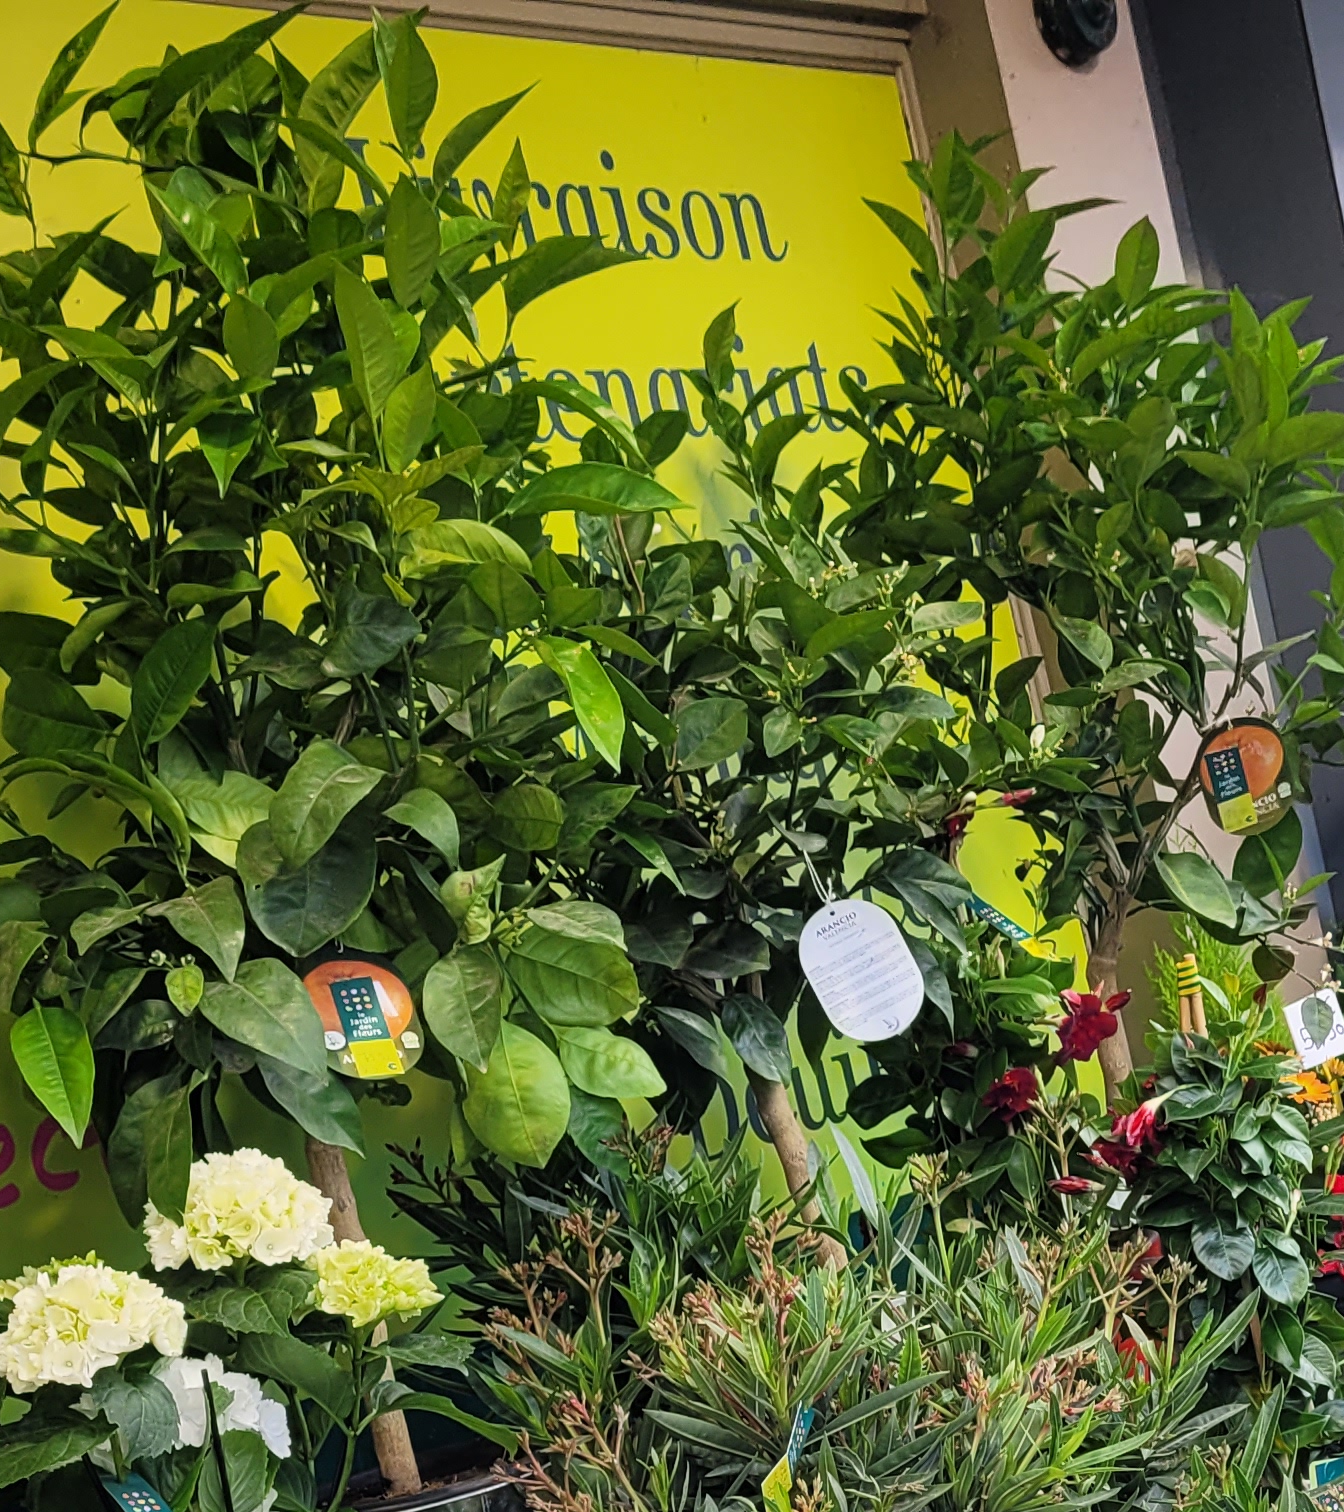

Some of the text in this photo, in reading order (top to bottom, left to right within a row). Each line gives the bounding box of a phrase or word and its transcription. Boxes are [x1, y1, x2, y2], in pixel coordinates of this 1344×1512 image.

[815, 911, 857, 939] ARANCIO
[349, 1016, 379, 1027] Jardin
[352, 1028, 383, 1038] Fleurs
